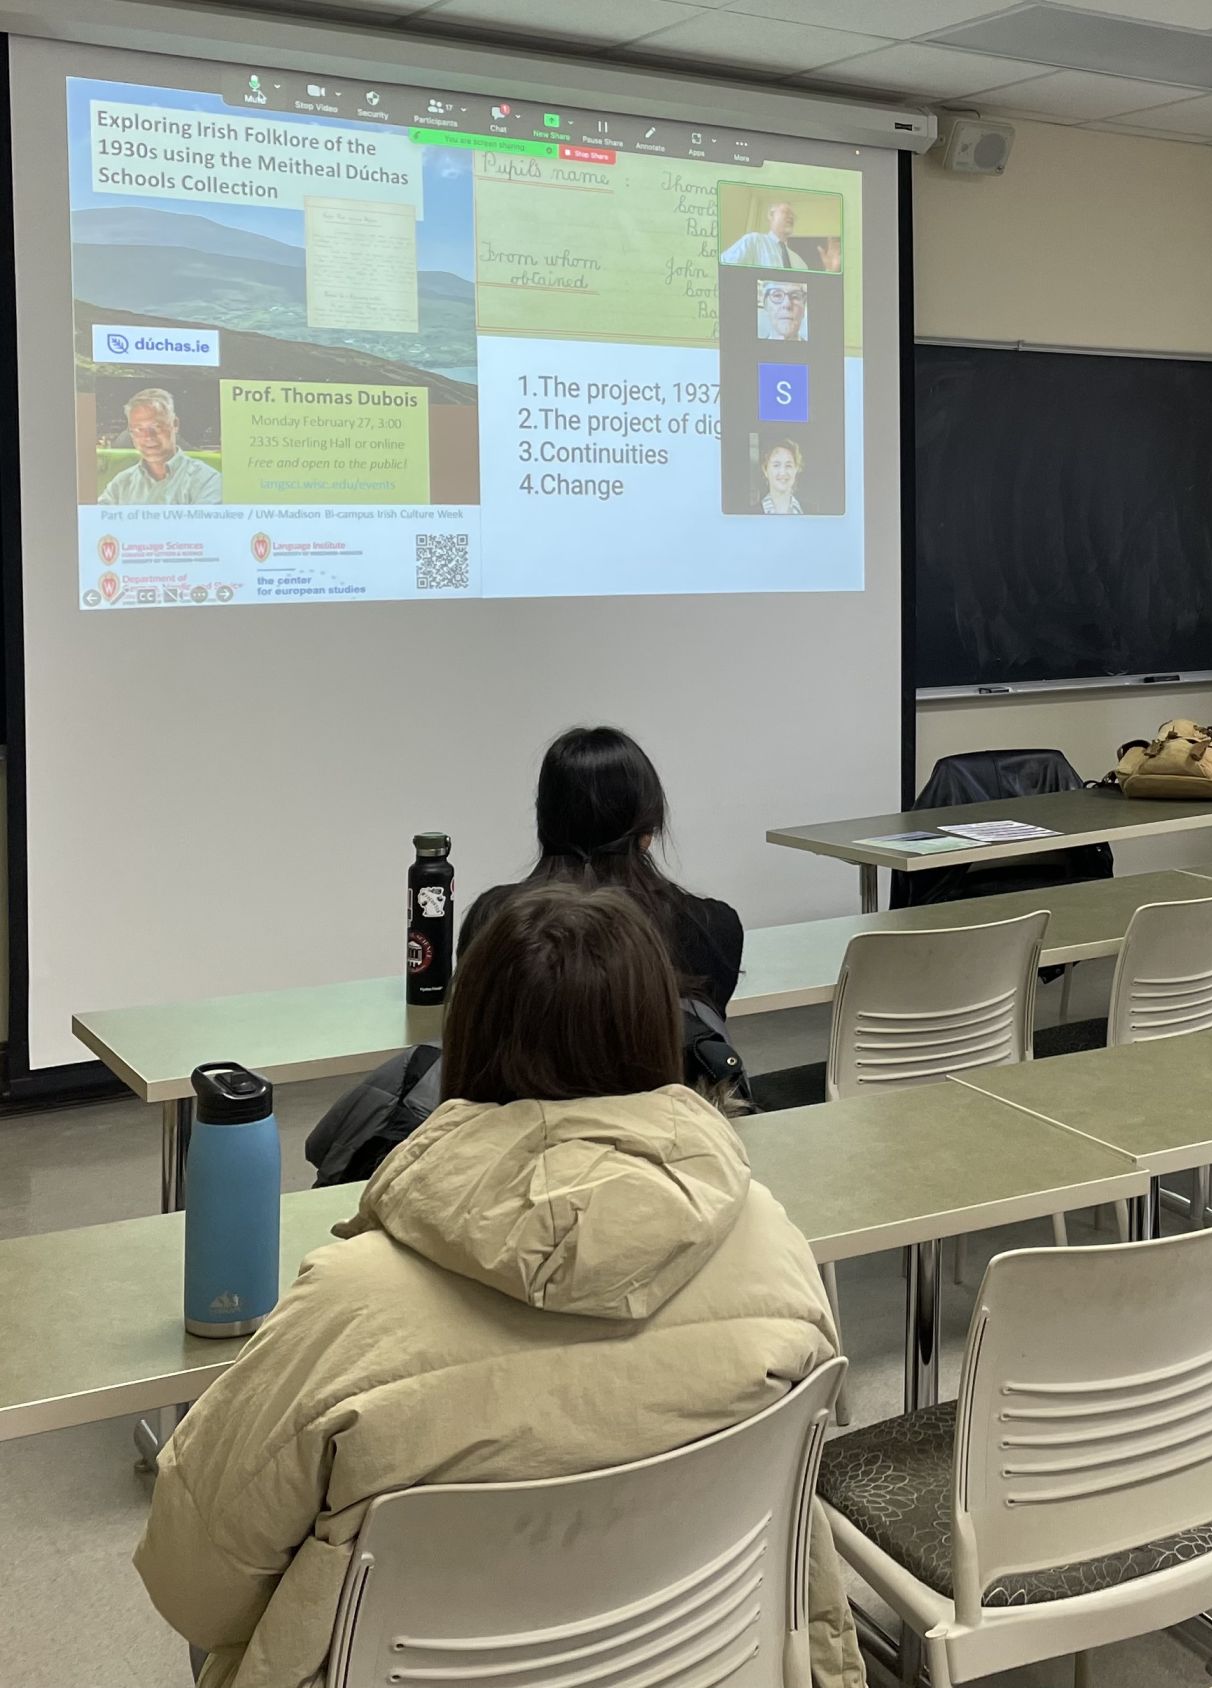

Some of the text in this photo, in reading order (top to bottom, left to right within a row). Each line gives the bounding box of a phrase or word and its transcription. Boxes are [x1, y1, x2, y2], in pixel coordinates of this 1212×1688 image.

[295, 101, 338, 113] Stop Video
[357, 109, 389, 120] Security
[414, 115, 458, 128] Participants
[490, 124, 507, 134] Chat
[97, 110, 376, 155] Exploring Irish Folklore of the
[533, 130, 570, 141] New Share
[582, 135, 624, 147] Pause Share
[635, 142, 666, 152] Annotate
[688, 149, 705, 158] Apps
[733, 154, 750, 162] More
[98, 138, 409, 185] 1930s using the Meitheal Dúchas
[98, 166, 278, 199] Schools Collection
[551, 167, 610, 185] name
[480, 241, 602, 271] From whom
[664, 256, 709, 286] John
[510, 271, 589, 289] obtained
[134, 337, 210, 353] dúchas.ie
[232, 386, 418, 408] Prof. Thomas Dubois
[588, 379, 666, 405] project,
[673, 382, 720, 404] 1937
[775, 380, 793, 405] S
[250, 414, 402, 430] Monday February 27, 3:00
[588, 411, 662, 437] project
[667, 412, 690, 434] of
[249, 436, 406, 451] 2335 Sterling Hall or online
[248, 456, 408, 471] Free and open to the public!
[101, 510, 123, 520] Part
[127, 510, 139, 520] of
[142, 510, 161, 520] the
[162, 509, 245, 520] UW-Milwaukee
[255, 509, 321, 519] UW-Madison
[324, 509, 374, 521] Bi-campus
[377, 509, 397, 519] Irish
[400, 509, 434, 519] Culture
[437, 509, 464, 519] Week
[121, 541, 204, 552] Language Sciences
[272, 541, 346, 552] Language Institute
[257, 576, 312, 586] the center
[257, 585, 366, 597] for european studies
